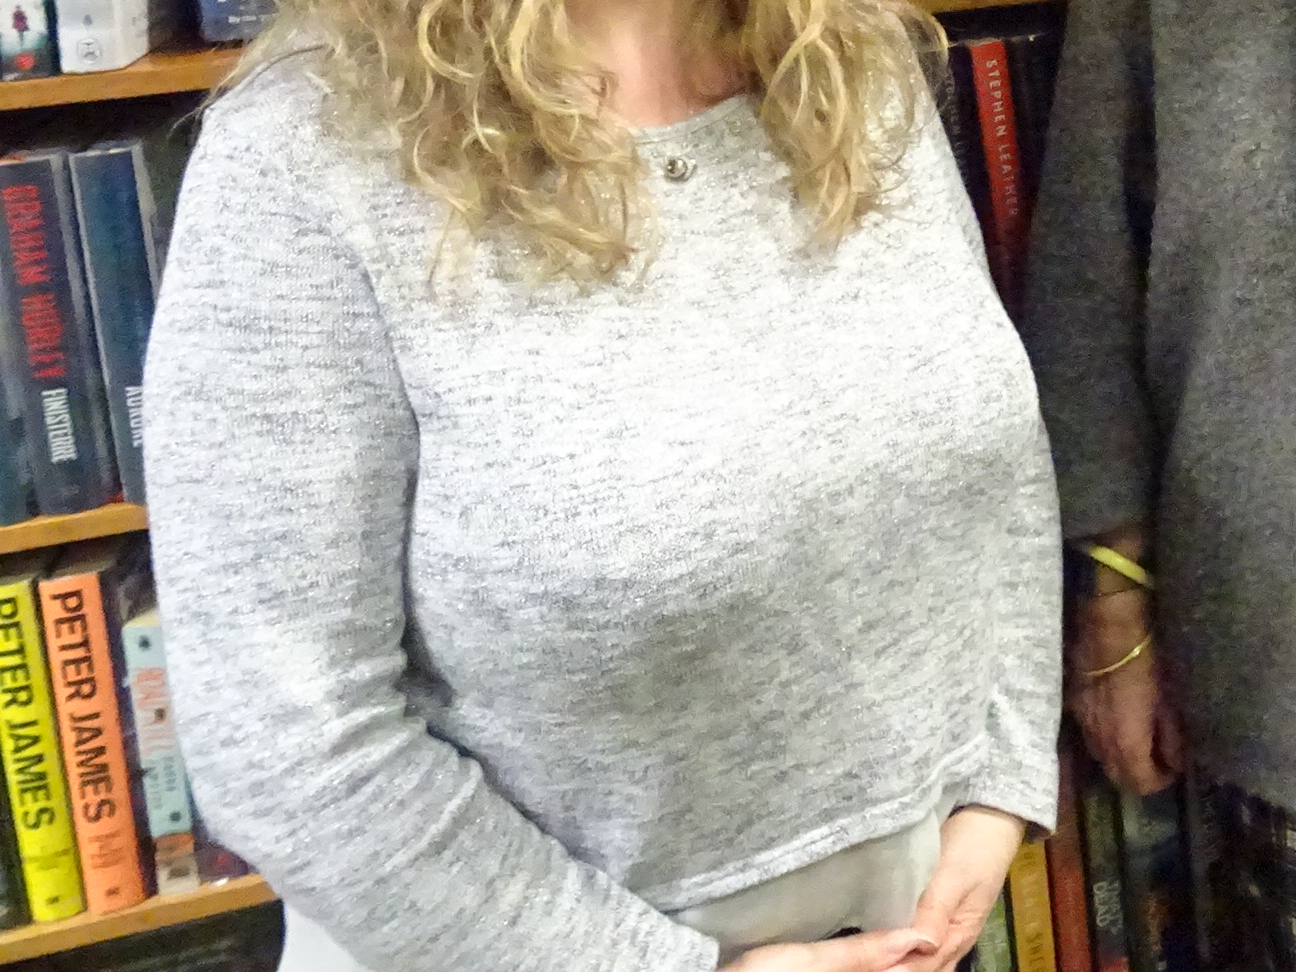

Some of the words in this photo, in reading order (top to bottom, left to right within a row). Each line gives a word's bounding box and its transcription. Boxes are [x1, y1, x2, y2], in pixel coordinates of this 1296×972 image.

[986, 58, 1008, 137] STEPHEN
[998, 145, 1019, 217] LEATHER
[41, 387, 78, 465] FINISTERRE
[50, 589, 98, 704] PETER
[9, 716, 57, 831] JAMES
[69, 711, 116, 824] JAMES
